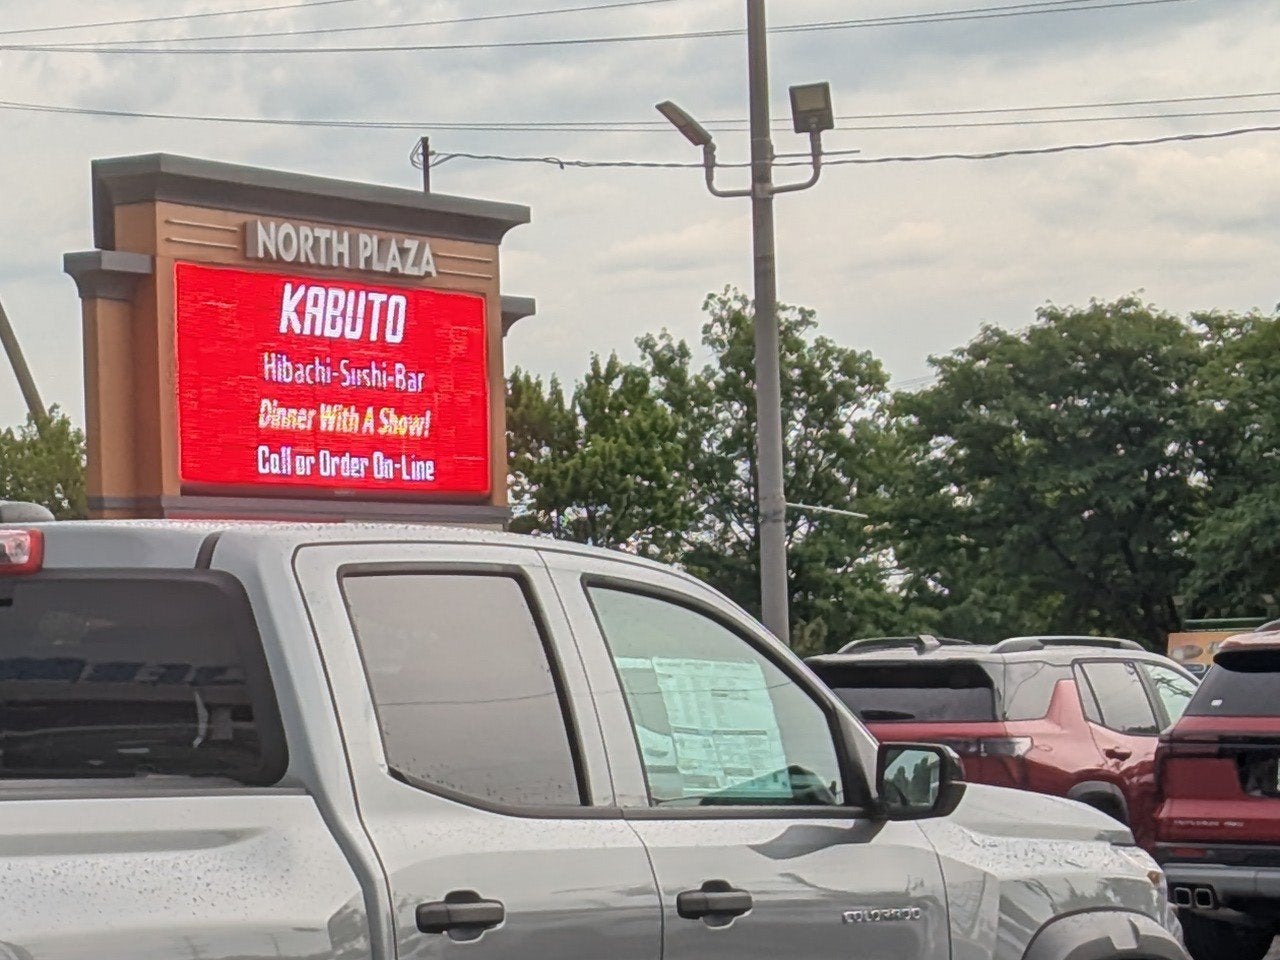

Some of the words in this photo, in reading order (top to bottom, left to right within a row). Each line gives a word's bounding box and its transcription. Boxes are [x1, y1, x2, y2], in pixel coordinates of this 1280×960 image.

[256, 220, 351, 268] NORTH
[358, 233, 438, 278] PLAZA
[279, 283, 408, 344] KABUTO
[258, 399, 316, 431] Dinner
[320, 403, 360, 433] With
[362, 407, 375, 435] A
[378, 407, 432, 438] Show!
[257, 445, 292, 476] Call
[295, 455, 316, 477] or
[319, 450, 369, 479] Order
[373, 451, 436, 482] On-Line
